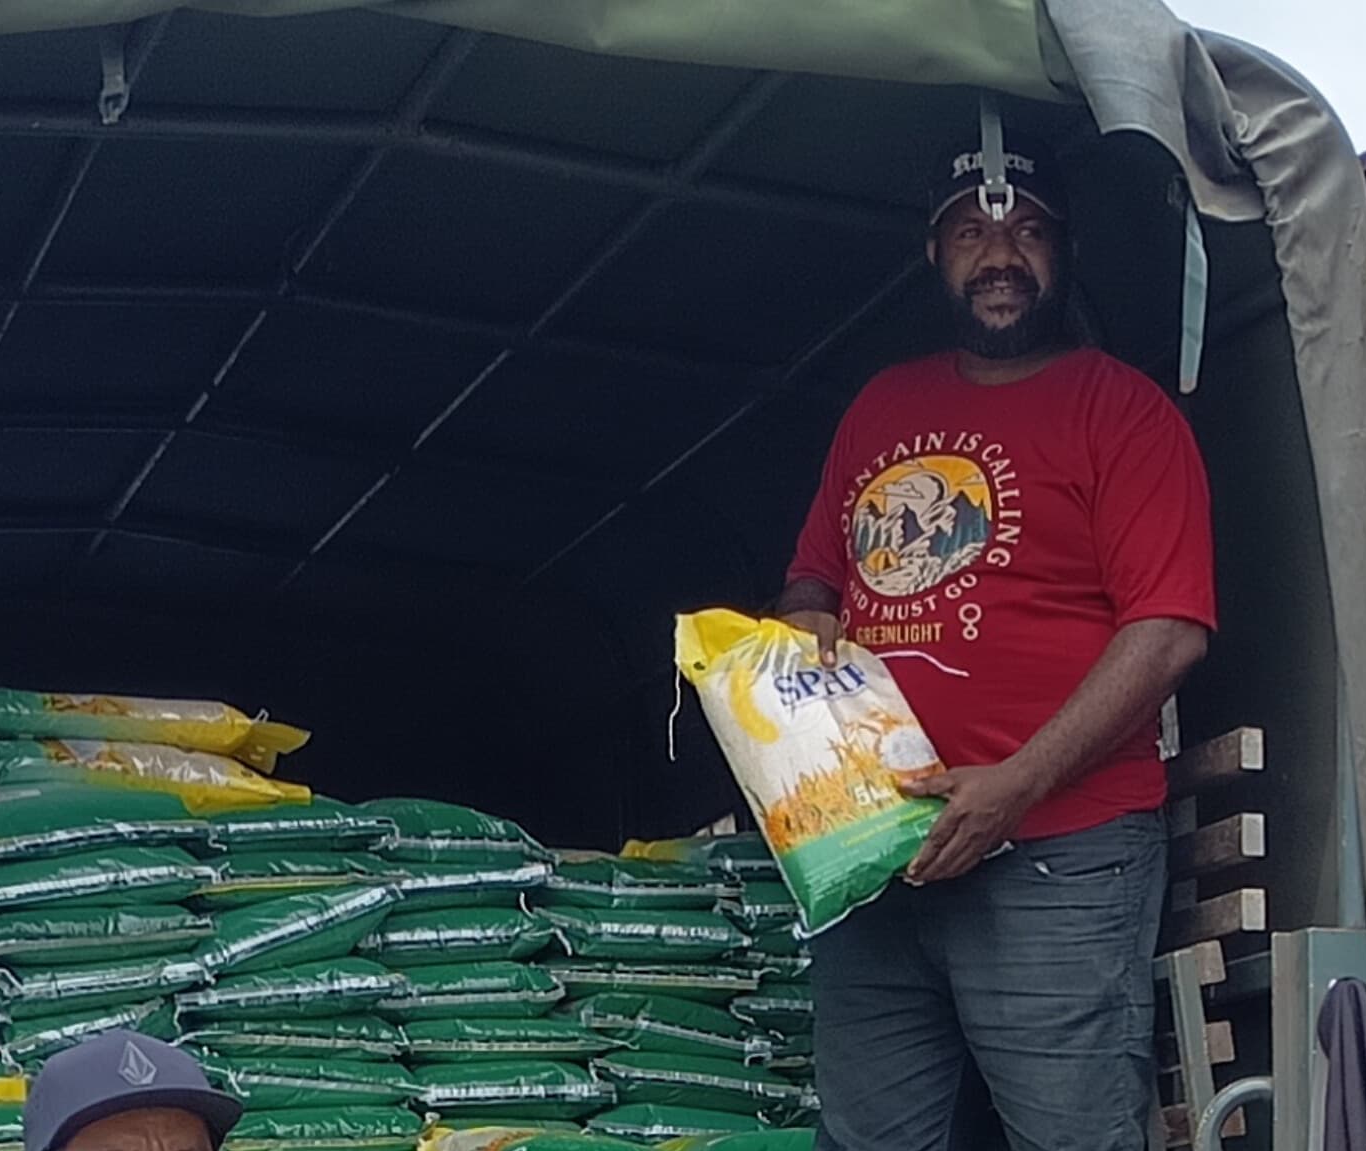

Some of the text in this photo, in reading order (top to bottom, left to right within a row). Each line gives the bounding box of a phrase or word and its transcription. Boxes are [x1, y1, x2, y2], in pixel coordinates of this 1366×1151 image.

[952, 431, 983, 452] IS
[981, 443, 1022, 567] CALLING
[881, 594, 938, 622] MUST
[944, 573, 978, 599] GO
